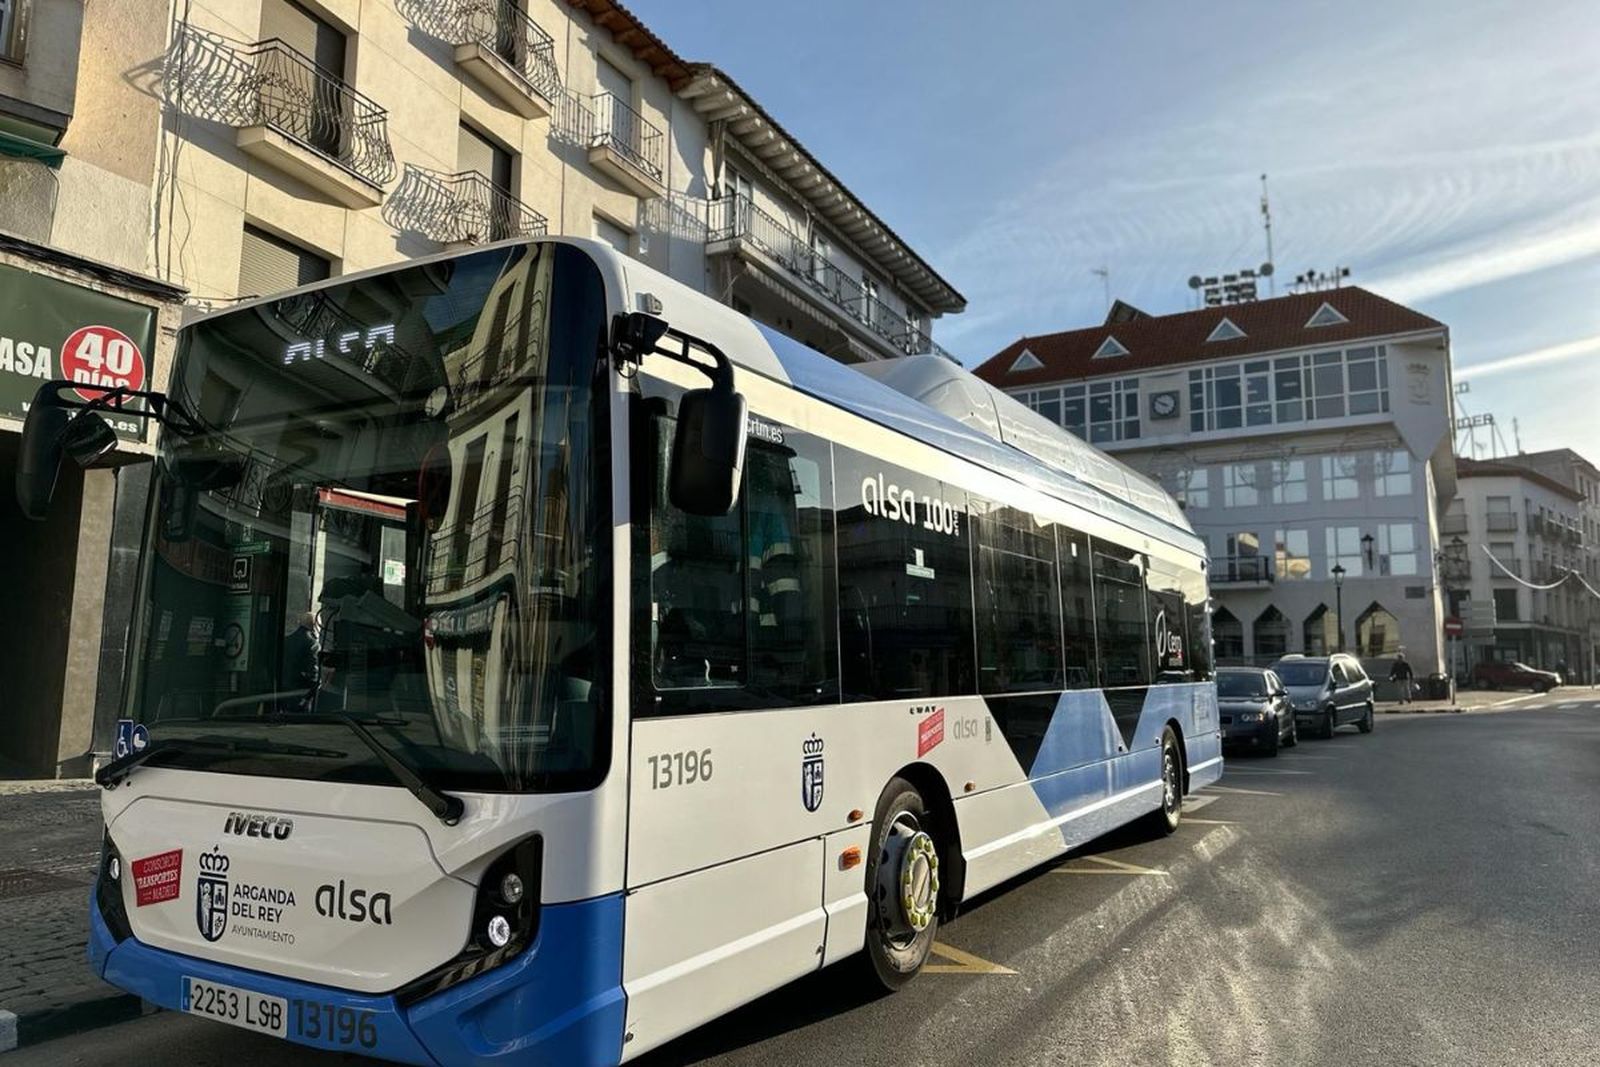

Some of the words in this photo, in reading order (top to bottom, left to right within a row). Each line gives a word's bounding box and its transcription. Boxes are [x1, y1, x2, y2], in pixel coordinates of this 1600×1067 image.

[0, 336, 52, 380] ASA
[75, 332, 134, 376] 40
[862, 472, 915, 525] alsa
[922, 496, 953, 535] 100
[953, 715, 978, 740] alsa
[648, 748, 713, 790] 13196
[224, 812, 294, 841] IVECO
[232, 901, 256, 919] DEL
[258, 905, 283, 923] REY
[233, 883, 296, 907] ARGANDA
[315, 879, 392, 925] alsa
[231, 924, 296, 945] AYUNTAMIENTO
[193, 984, 239, 1020] 2253
[246, 996, 282, 1030] LSB
[292, 1001, 378, 1048] 13196
